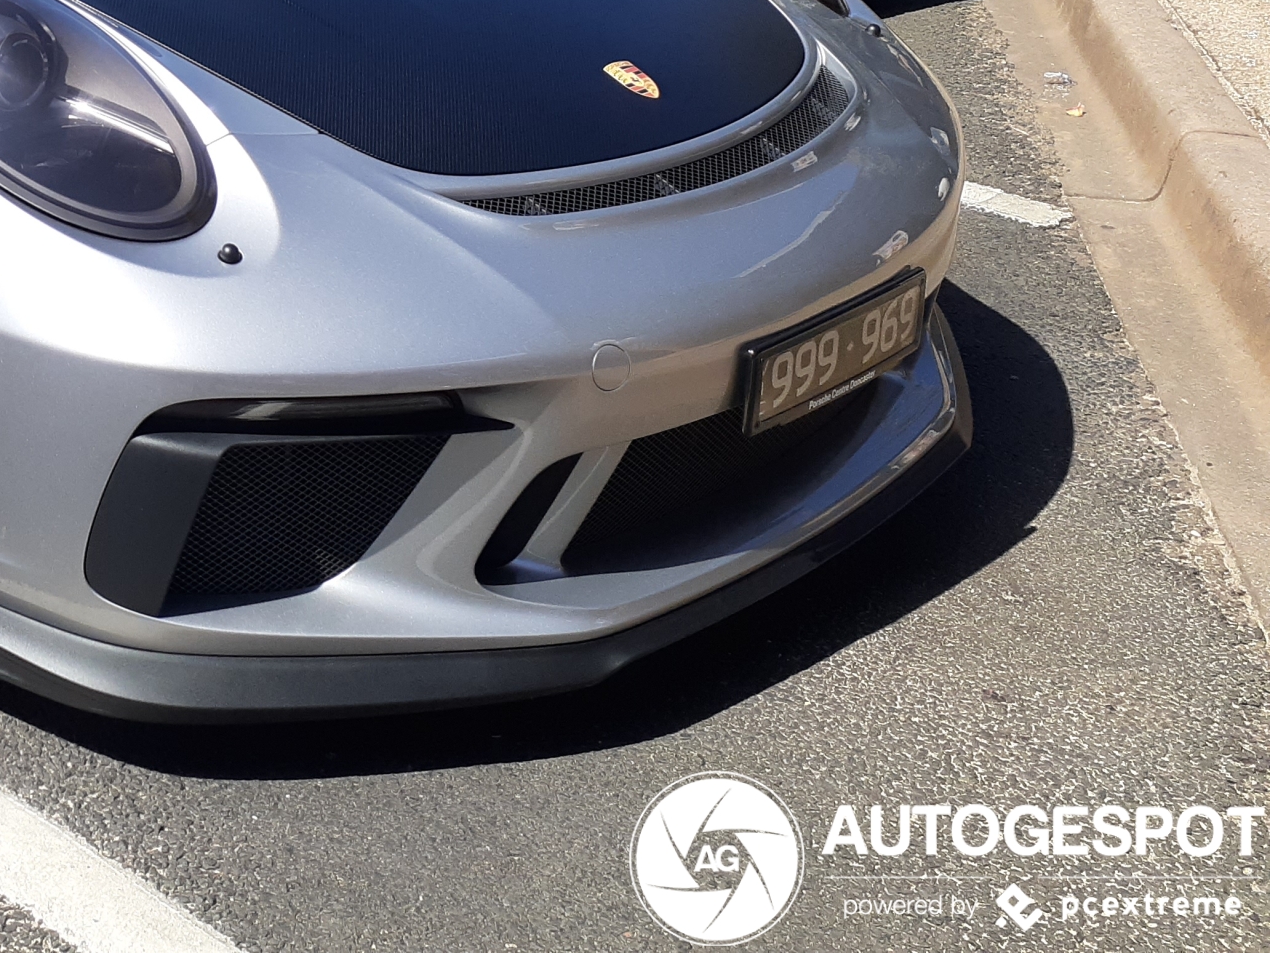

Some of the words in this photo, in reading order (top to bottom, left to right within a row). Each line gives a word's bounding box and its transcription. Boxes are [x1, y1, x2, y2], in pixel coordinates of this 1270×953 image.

[808, 392, 831, 411] Porsche
[831, 382, 850, 399] Centre
[849, 369, 876, 390] Doncaster
